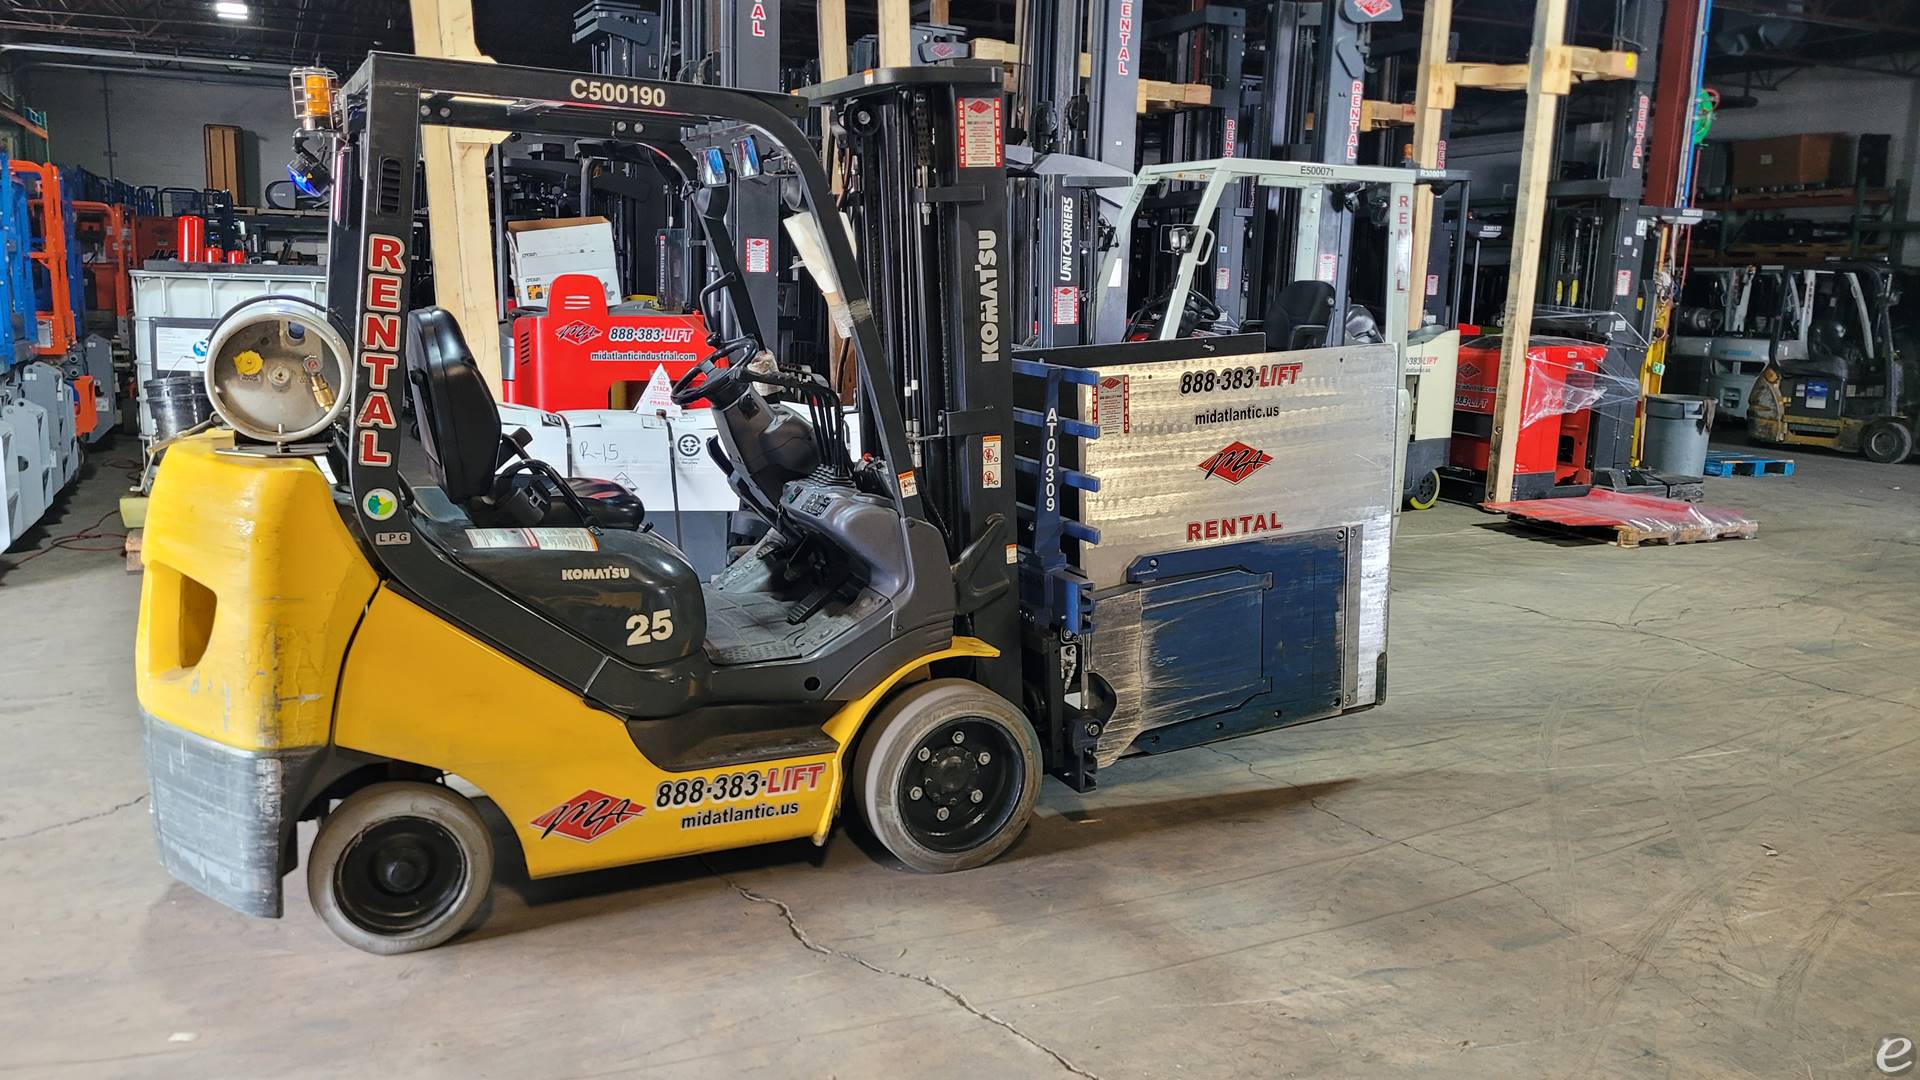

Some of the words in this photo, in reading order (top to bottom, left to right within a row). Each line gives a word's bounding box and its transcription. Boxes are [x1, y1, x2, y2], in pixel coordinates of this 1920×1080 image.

[1118, 0, 1132, 76] ENTAL
[570, 78, 666, 107] C500190
[1347, 80, 1363, 159] RENTAL
[1300, 165, 1335, 177] E500071
[1060, 195, 1073, 281] UNICARRIERS
[974, 230, 999, 363] KOMATSU
[356, 234, 405, 466] RENTAL
[591, 351, 697, 361] midatlanticindustrial.com
[1195, 405, 1279, 425] midatlantic.us
[1046, 407, 1057, 512] AT00309
[1186, 512, 1283, 543] RENTAL
[561, 565, 630, 581] KOMATSU
[625, 608, 674, 646] 25
[681, 801, 799, 829] midatlantic.us
